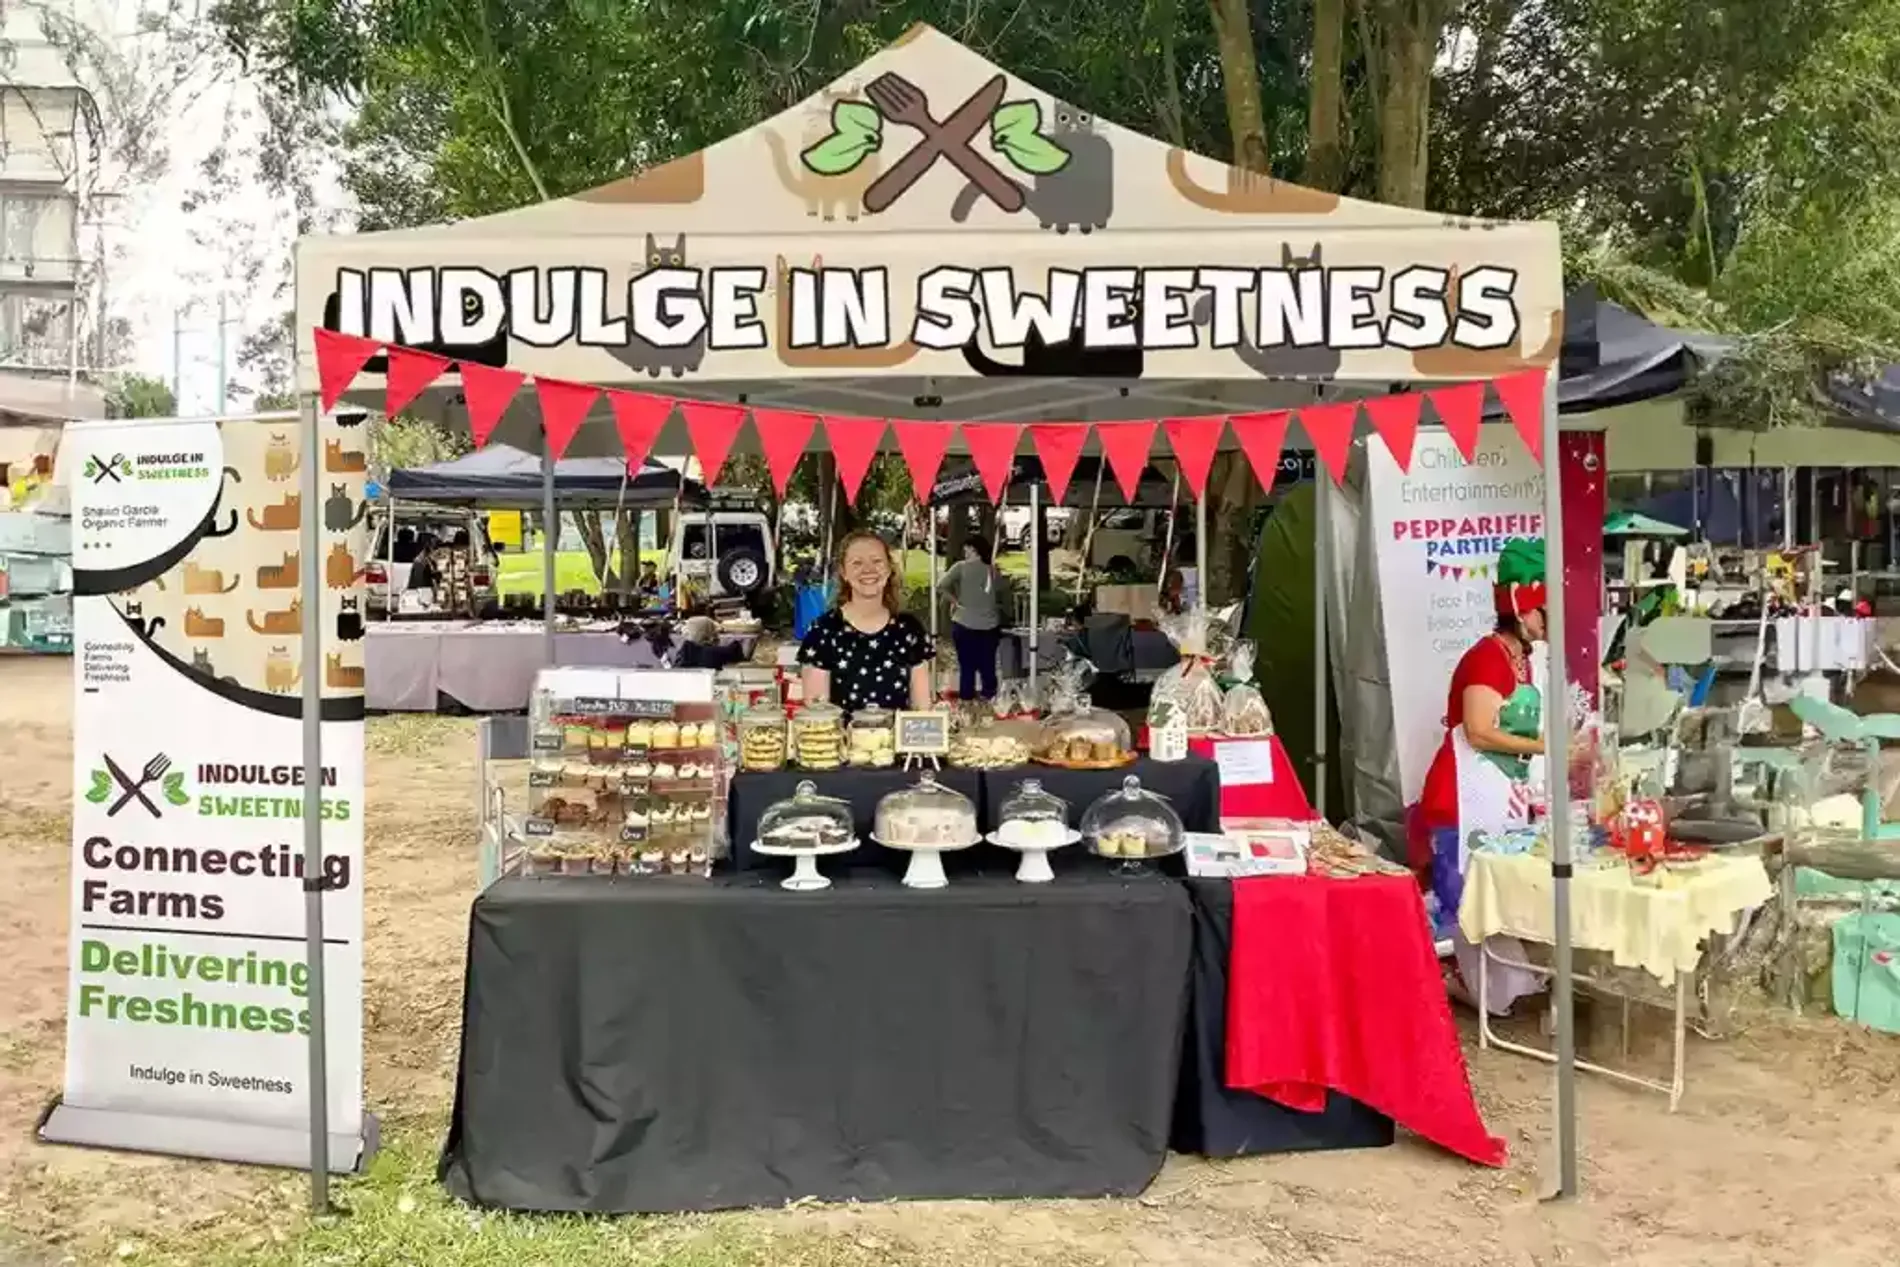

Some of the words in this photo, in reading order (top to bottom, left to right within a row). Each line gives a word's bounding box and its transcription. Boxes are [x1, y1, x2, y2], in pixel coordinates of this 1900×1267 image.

[336, 266, 768, 349] INDULGE
[789, 266, 891, 348] IN
[911, 265, 1521, 350] SWEETNESS
[137, 453, 188, 465] INDULGE
[191, 453, 204, 463] IN
[137, 468, 209, 480] SWEETNESS
[122, 505, 160, 516] Garcia
[82, 518, 125, 531] Organic
[128, 517, 168, 528] Farmer
[198, 764, 305, 785] INDULGE
[198, 795, 350, 820] SWEETNSS
[83, 880, 225, 920] Farms
[129, 1064, 186, 1085] Indulge
[189, 1069, 204, 1084] in
[208, 1070, 293, 1094] Sweetness
